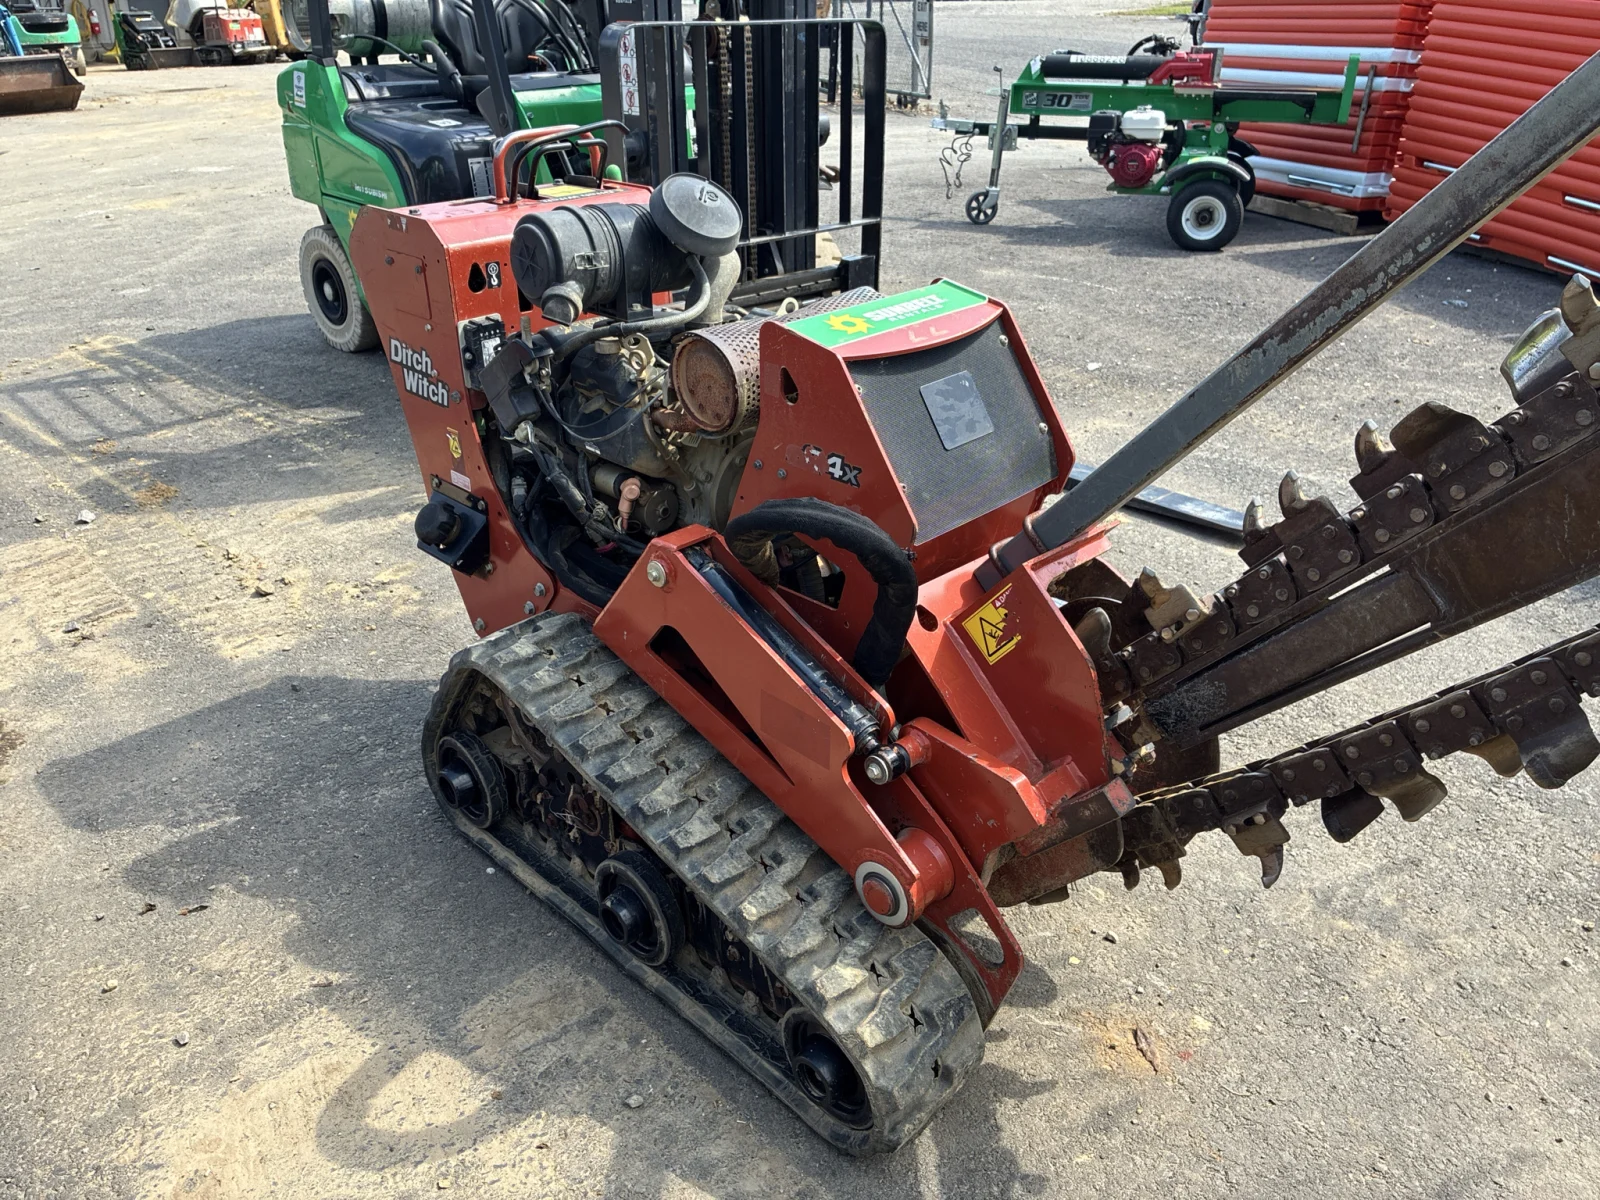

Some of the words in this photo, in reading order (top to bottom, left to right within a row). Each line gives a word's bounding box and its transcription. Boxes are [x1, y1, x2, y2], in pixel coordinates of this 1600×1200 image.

[1043, 93, 1073, 108] 30
[863, 294, 946, 322] SUNBELT
[888, 304, 944, 322] RENTALS
[390, 338, 432, 375] Ditch
[403, 367, 448, 407] Witch
